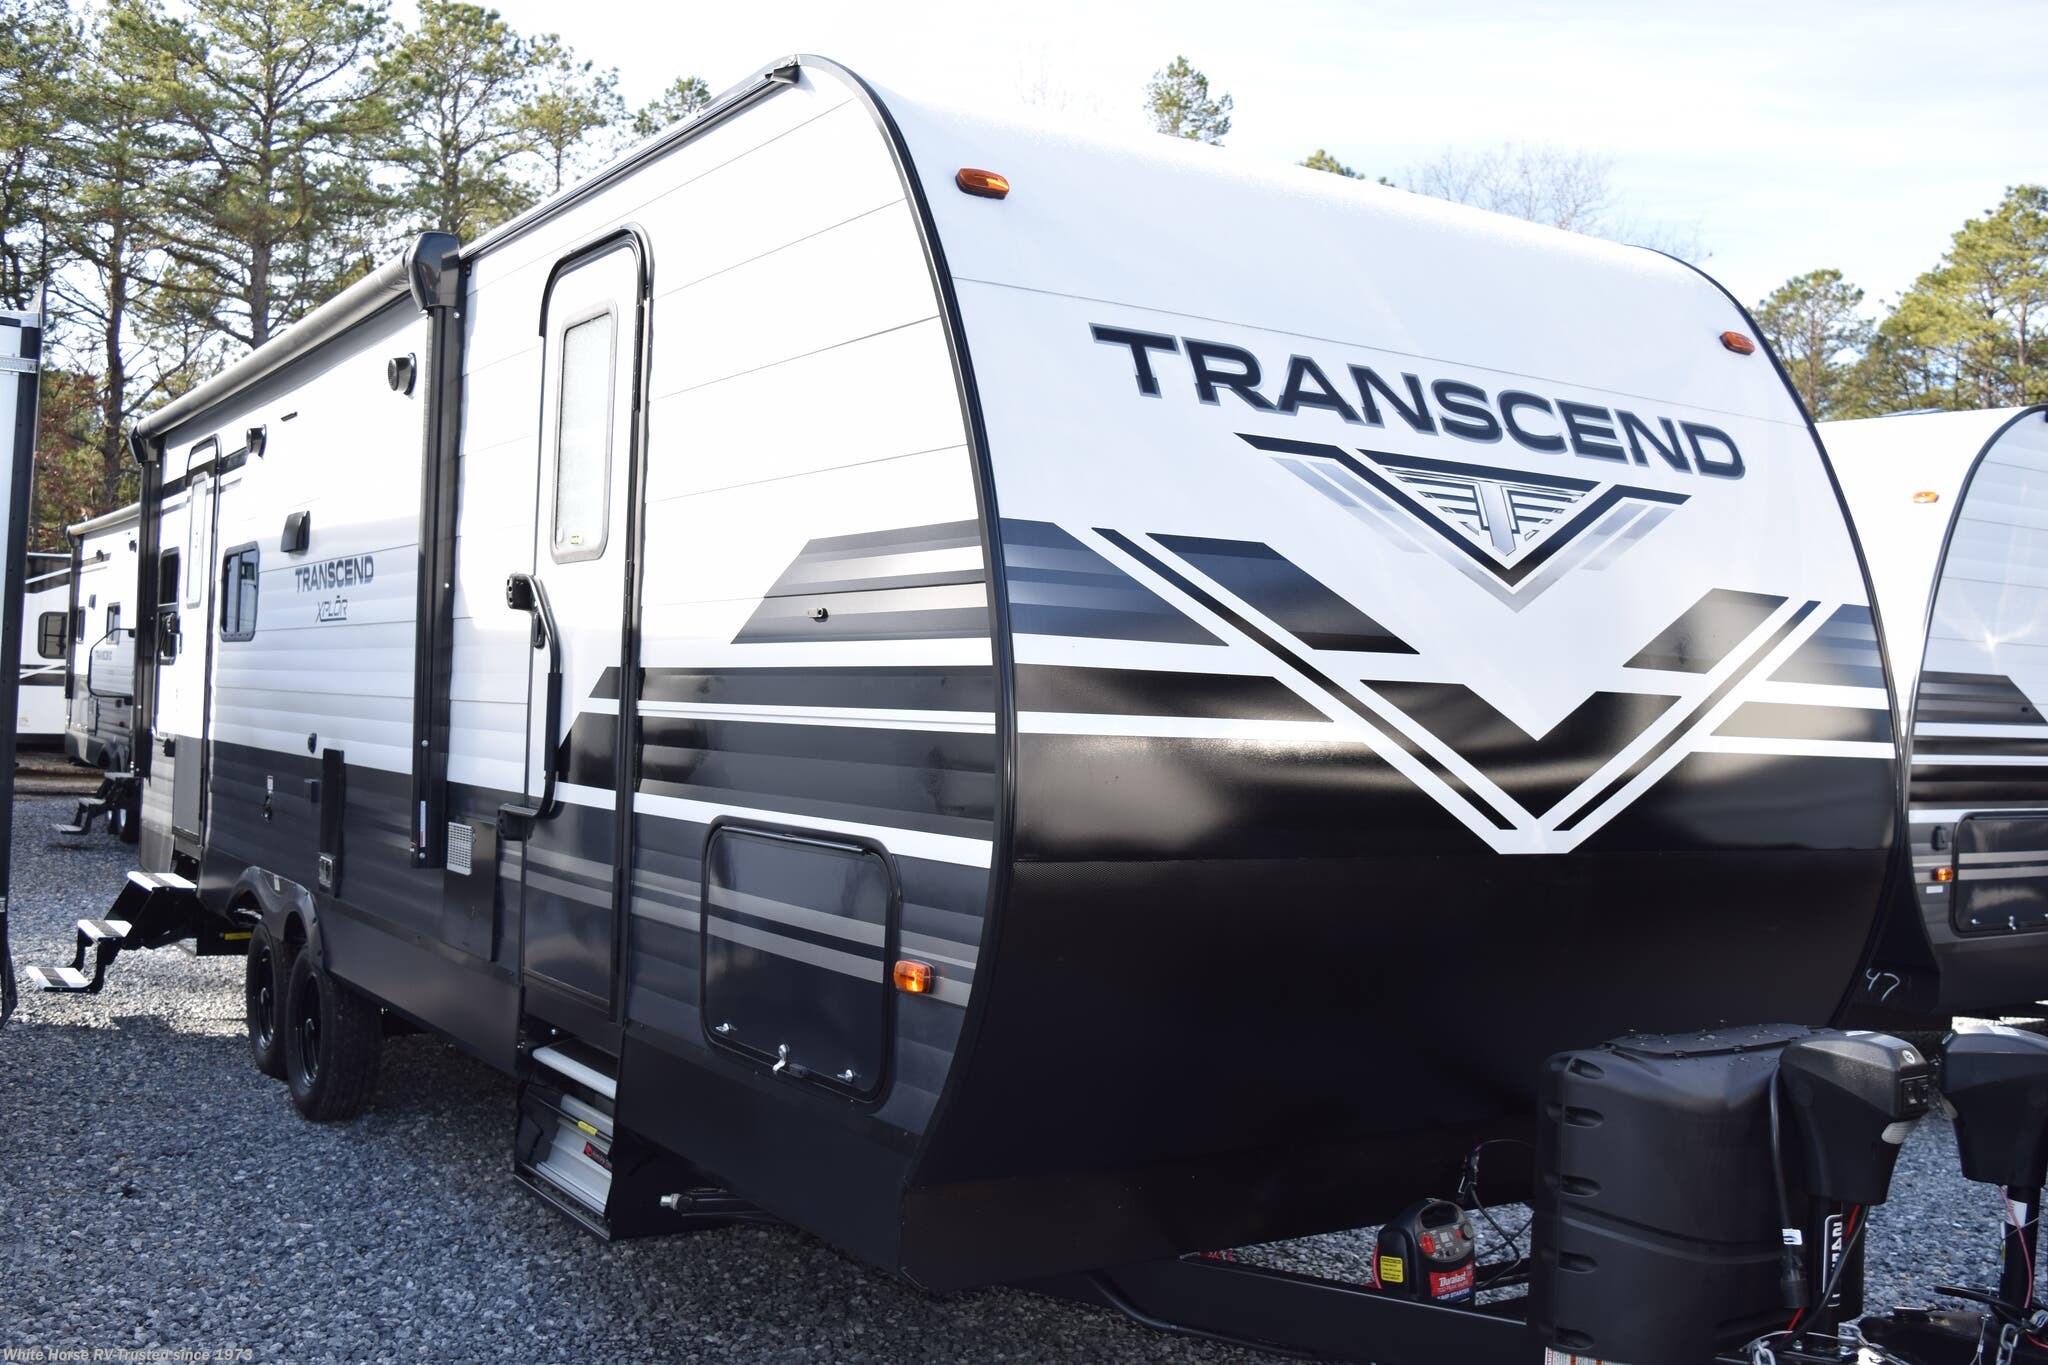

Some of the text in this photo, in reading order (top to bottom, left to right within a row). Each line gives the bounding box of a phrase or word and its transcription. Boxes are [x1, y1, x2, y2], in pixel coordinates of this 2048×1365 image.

[1089, 322, 1746, 480] TRANSCEND
[295, 555, 374, 592] TRANSCEND
[1865, 968, 1900, 1001] 47
